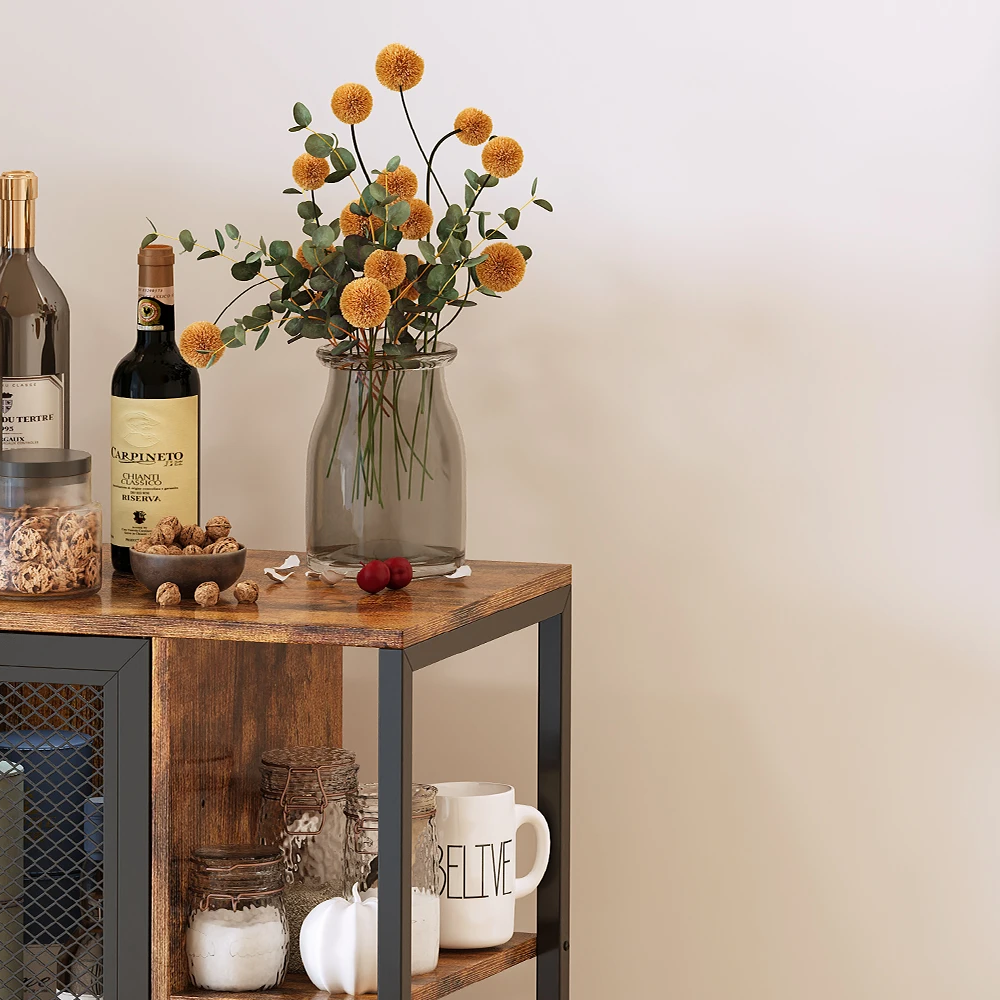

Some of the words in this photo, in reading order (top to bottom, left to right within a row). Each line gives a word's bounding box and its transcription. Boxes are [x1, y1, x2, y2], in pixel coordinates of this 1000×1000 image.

[16, 413, 55, 423] TERTRE
[110, 446, 184, 461] CARPINETO
[122, 472, 160, 480] CHIANTI
[121, 494, 162, 502] RISERVA
